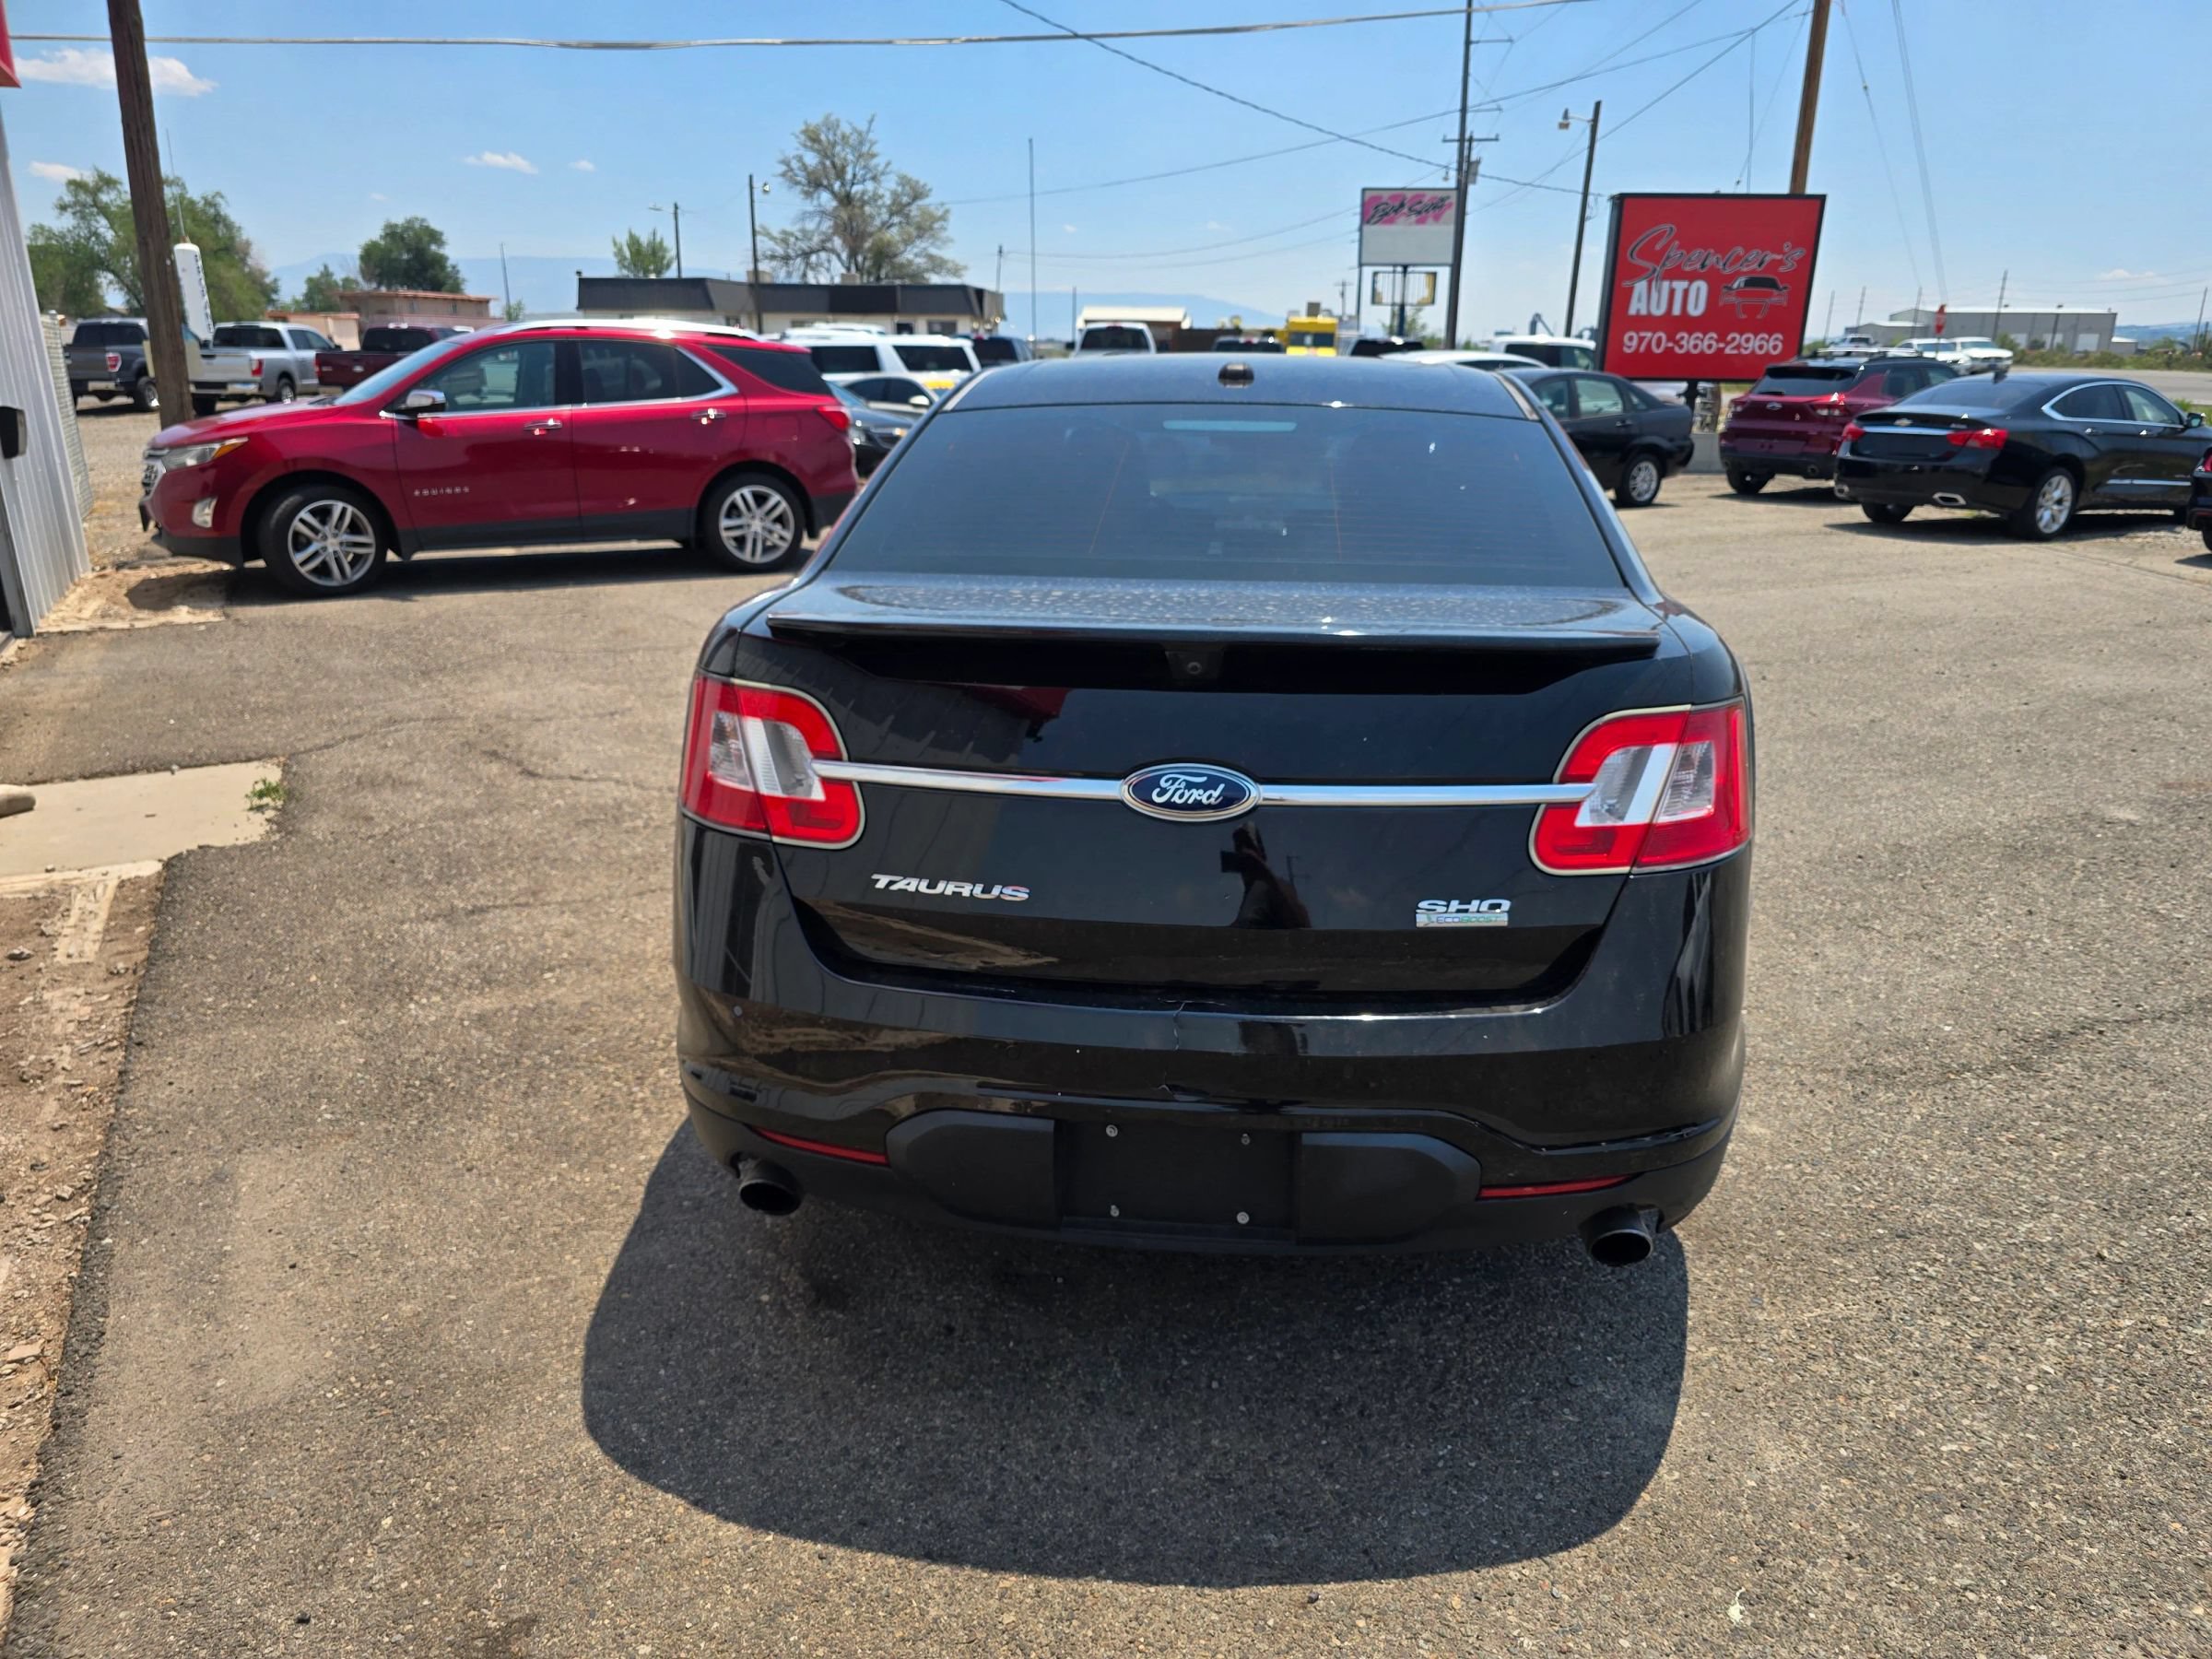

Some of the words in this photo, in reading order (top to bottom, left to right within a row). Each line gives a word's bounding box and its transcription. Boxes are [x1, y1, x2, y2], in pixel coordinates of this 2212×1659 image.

[1622, 224, 1806, 294] Spencer's
[1628, 279, 1708, 316] AUTO
[1623, 331, 1783, 355] 970-366-2966
[1152, 774, 1226, 805] Ford
[871, 874, 1030, 902] TAURUS
[1416, 899, 1512, 913] SHO
